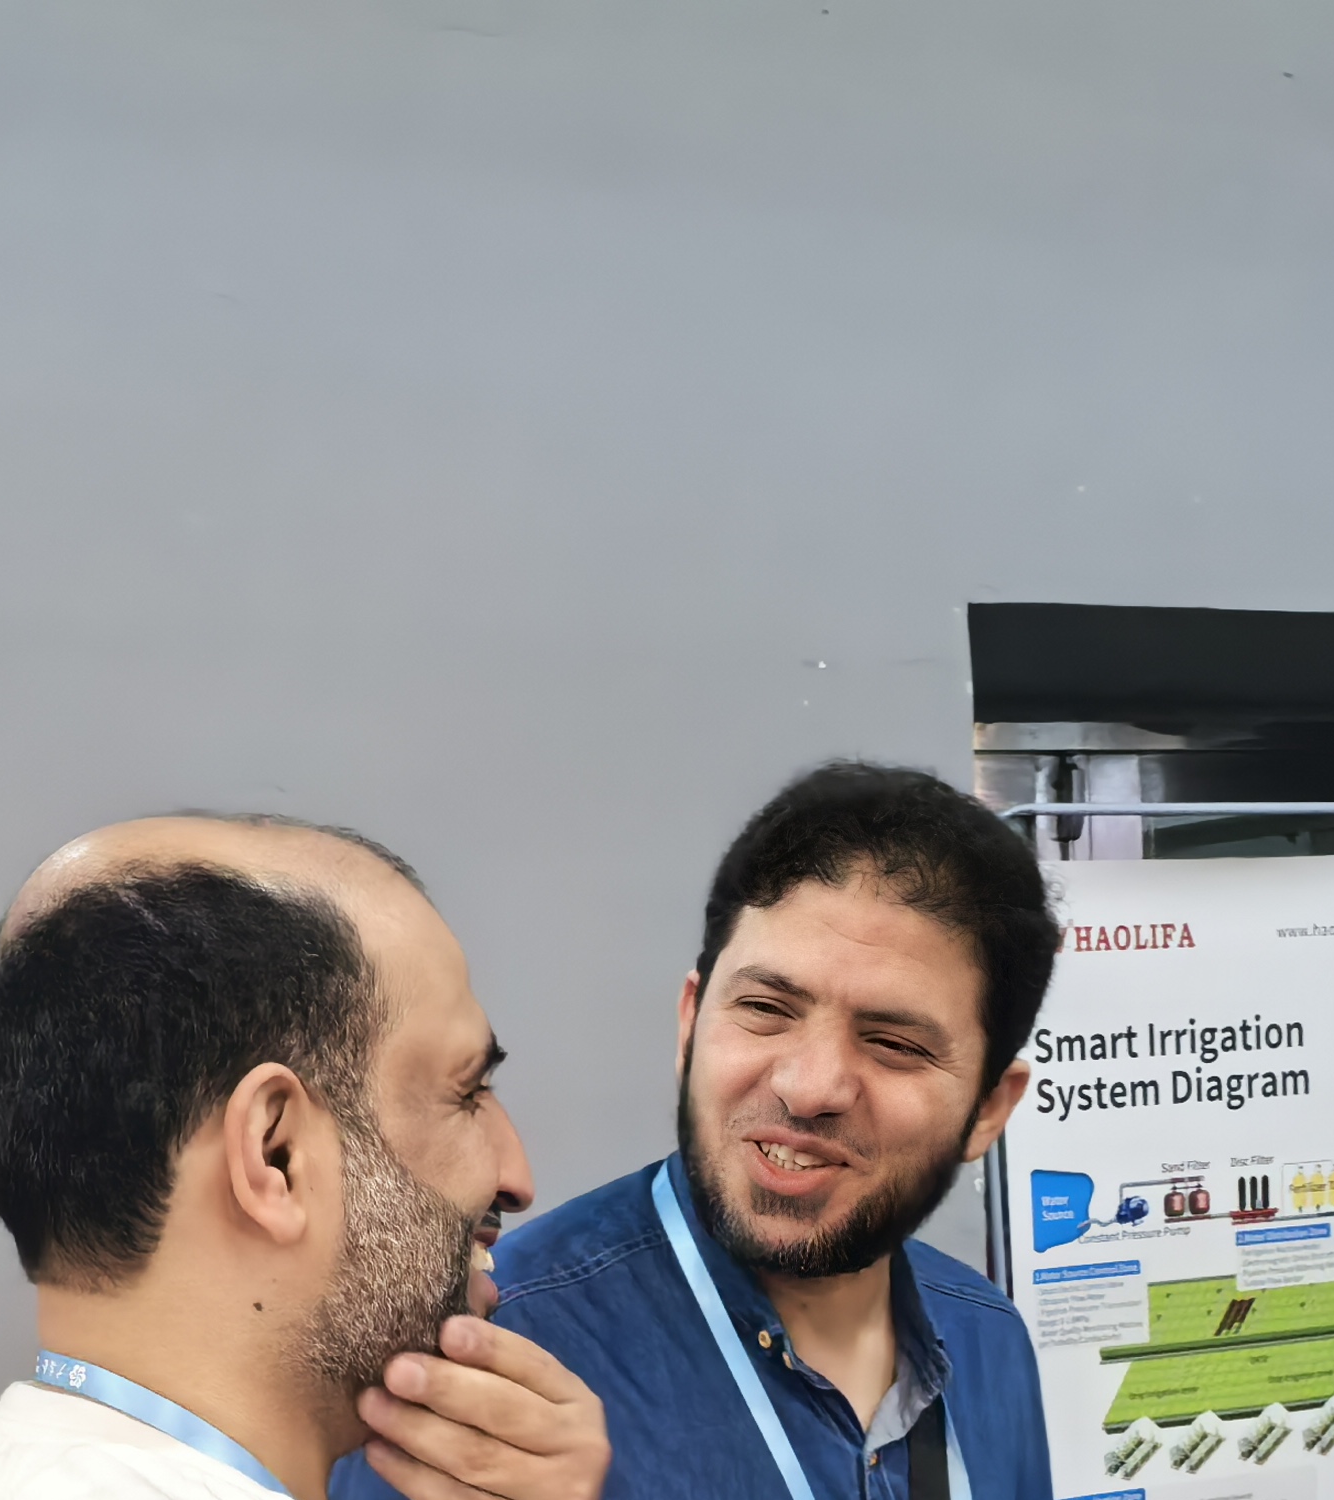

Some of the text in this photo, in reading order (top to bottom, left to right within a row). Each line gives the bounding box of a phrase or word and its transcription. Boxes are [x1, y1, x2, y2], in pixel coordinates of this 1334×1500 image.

[1074, 923, 1196, 952] HAOLIFA
[1034, 1014, 1305, 1064] Smart Irrigation
[1036, 1066, 1311, 1122] System Diagram
